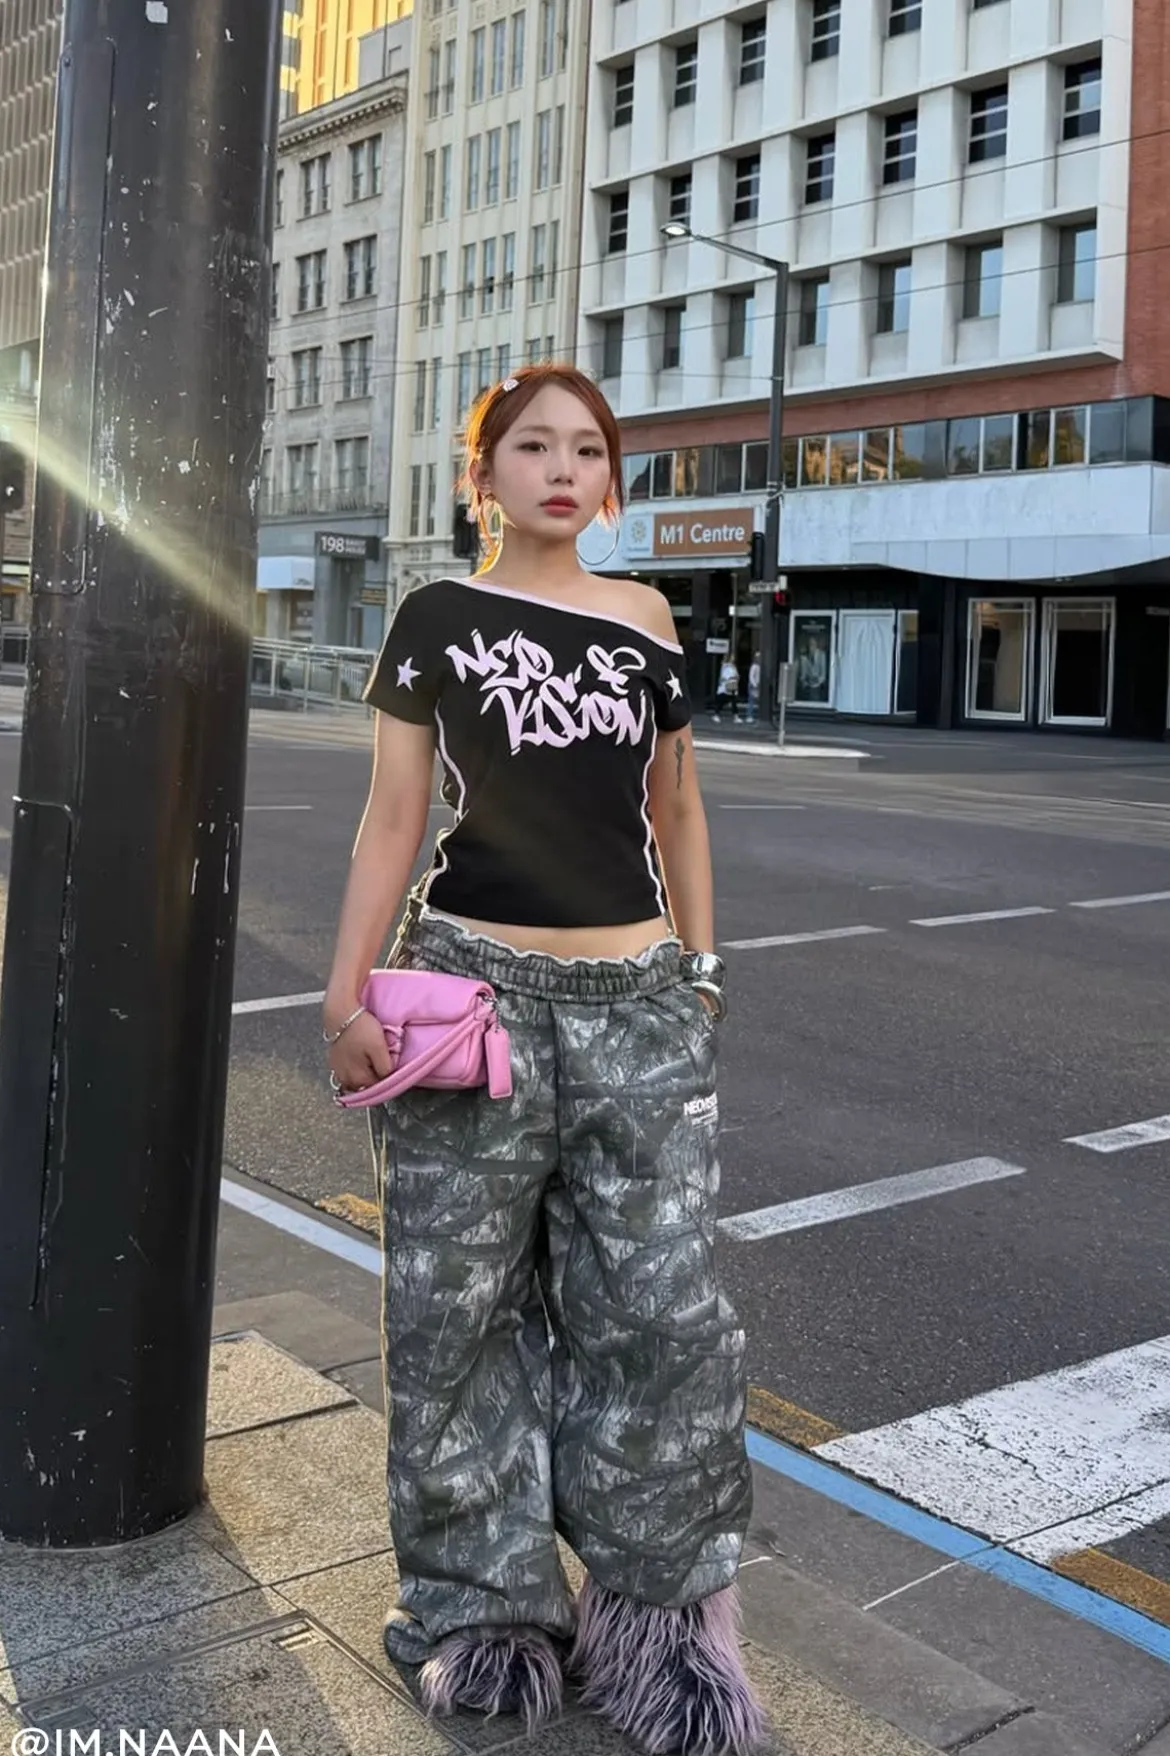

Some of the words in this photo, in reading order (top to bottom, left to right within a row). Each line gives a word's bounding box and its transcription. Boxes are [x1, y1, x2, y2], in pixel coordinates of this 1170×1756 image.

[321, 535, 345, 554] 198
[660, 525, 684, 545] M1
[690, 523, 745, 544] Centre
[445, 628, 554, 692] NEO
[480, 664, 647, 756] VISION
